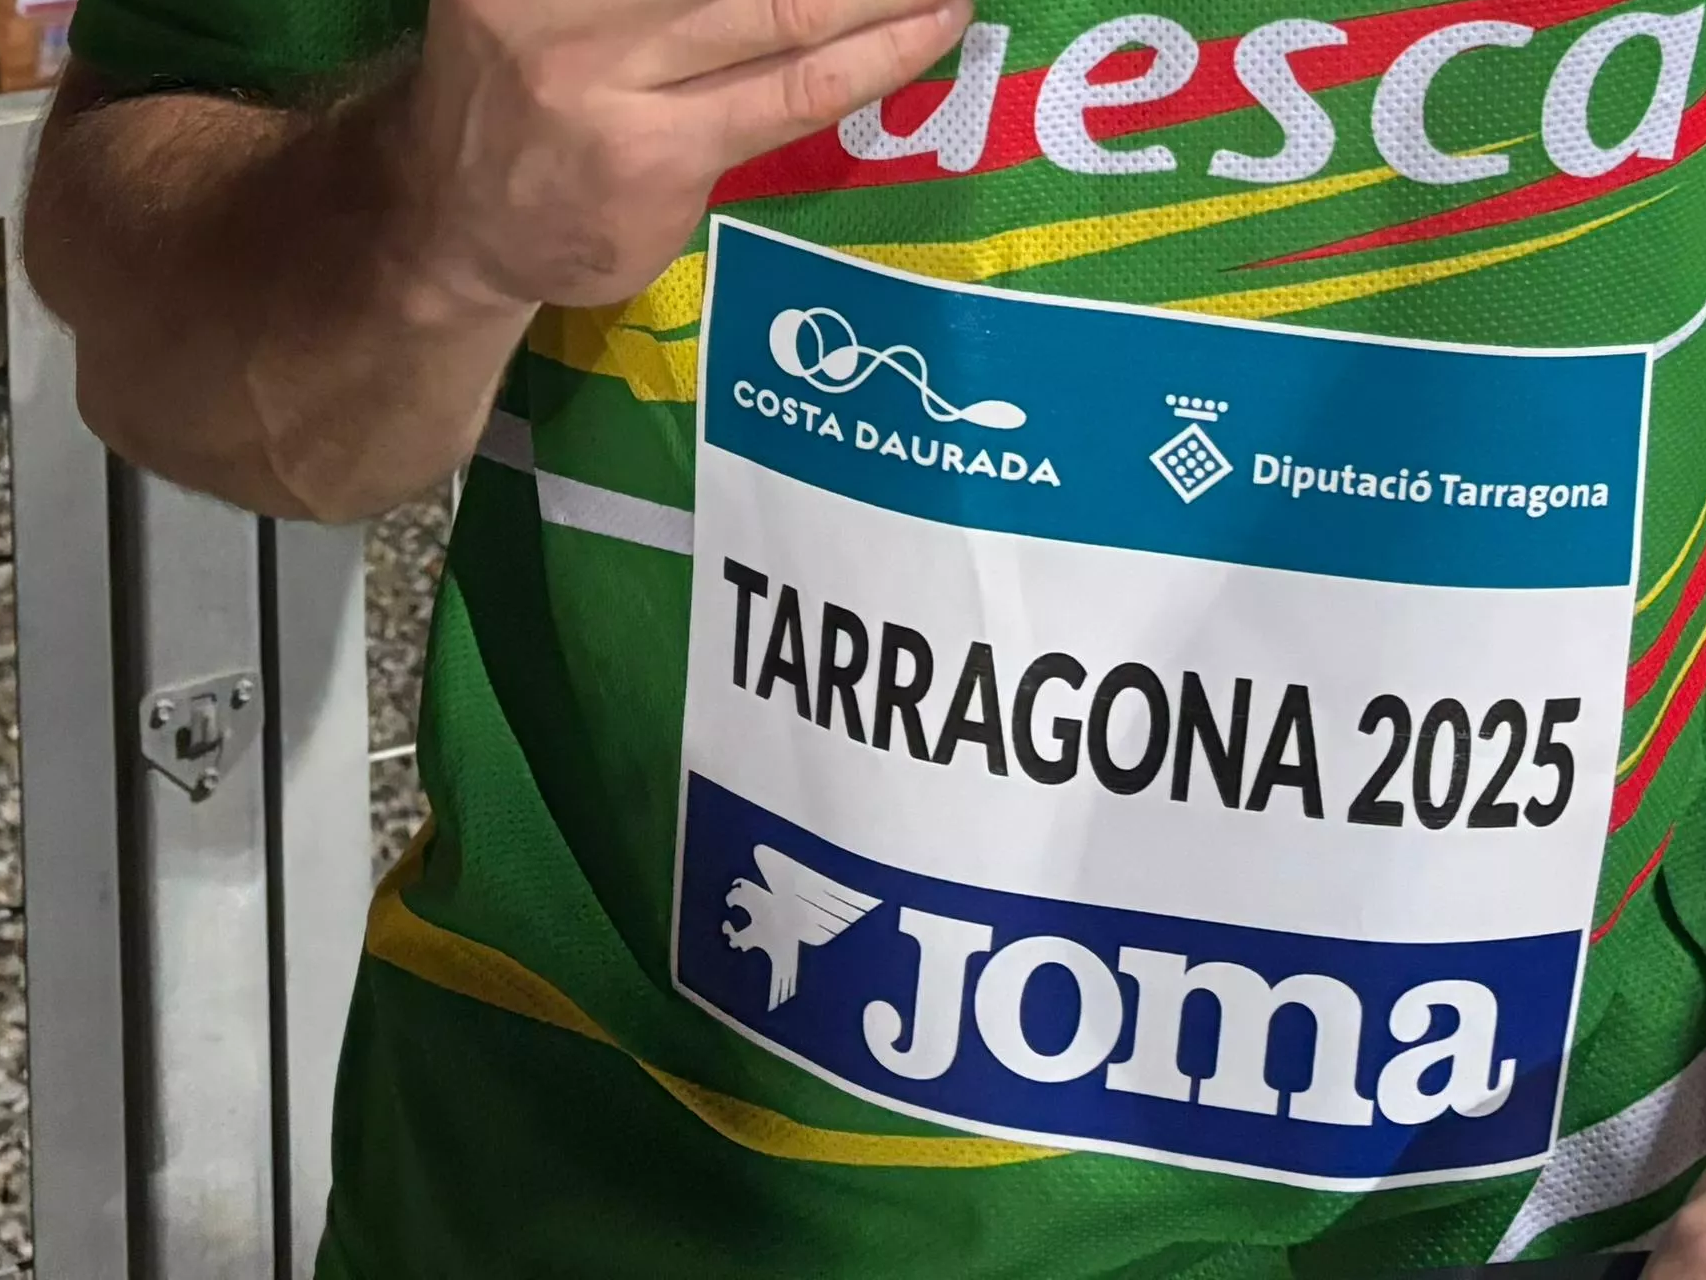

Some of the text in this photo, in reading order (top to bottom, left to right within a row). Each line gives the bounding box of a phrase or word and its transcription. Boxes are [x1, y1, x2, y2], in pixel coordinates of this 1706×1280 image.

[731, 379, 1062, 489] COSTA DAURADA
[1251, 451, 1610, 519] Diputació Tarragona
[723, 555, 1583, 831] TARRAGONA 2025
